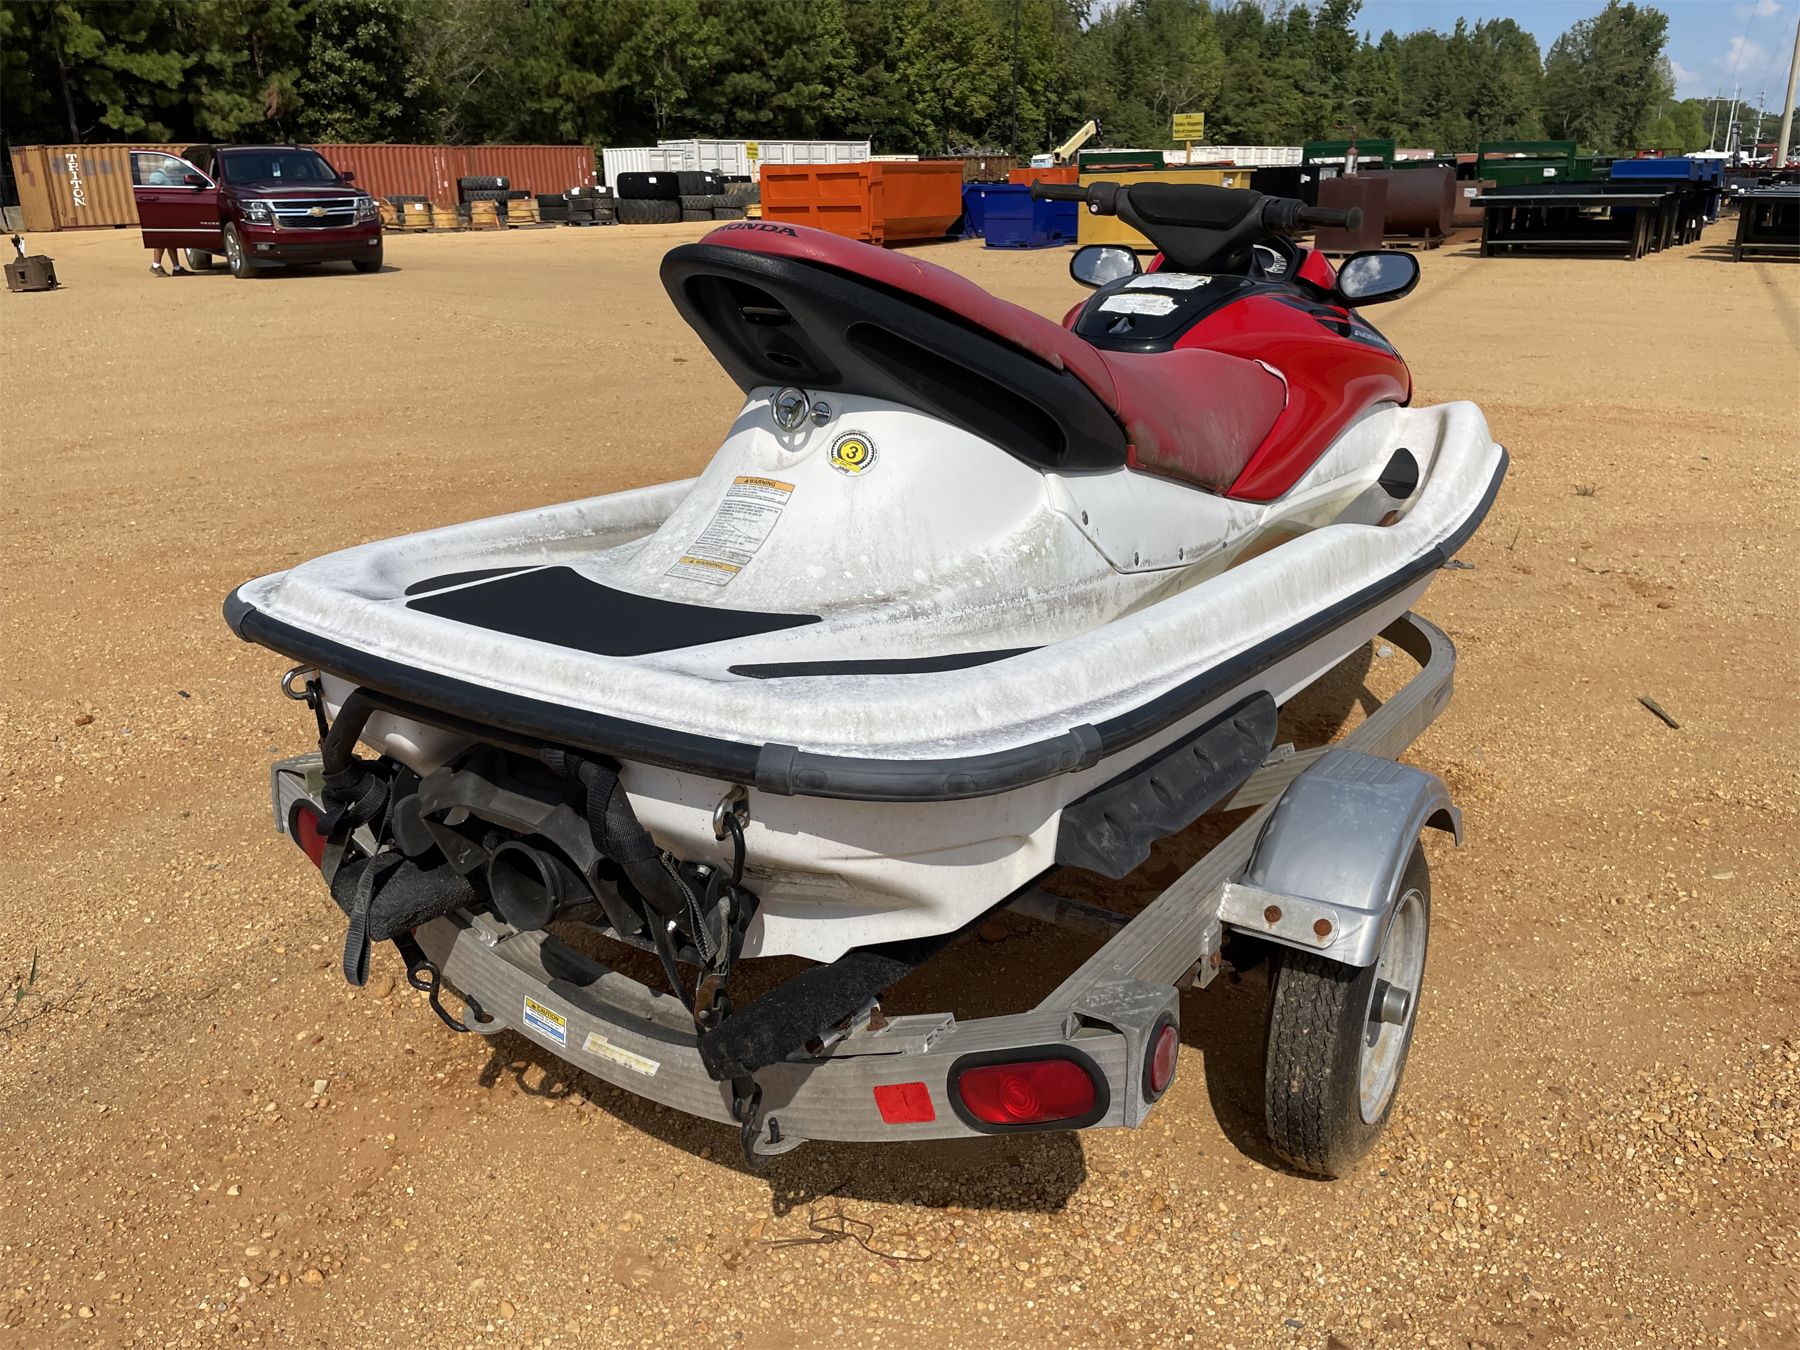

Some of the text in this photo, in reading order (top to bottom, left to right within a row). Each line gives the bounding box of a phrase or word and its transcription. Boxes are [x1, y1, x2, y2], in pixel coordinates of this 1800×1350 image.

[65, 153, 86, 207] TRITON
[846, 446, 859, 459] 3
[749, 479, 777, 487] WARNING
[535, 1004, 560, 1022] CAUTION
